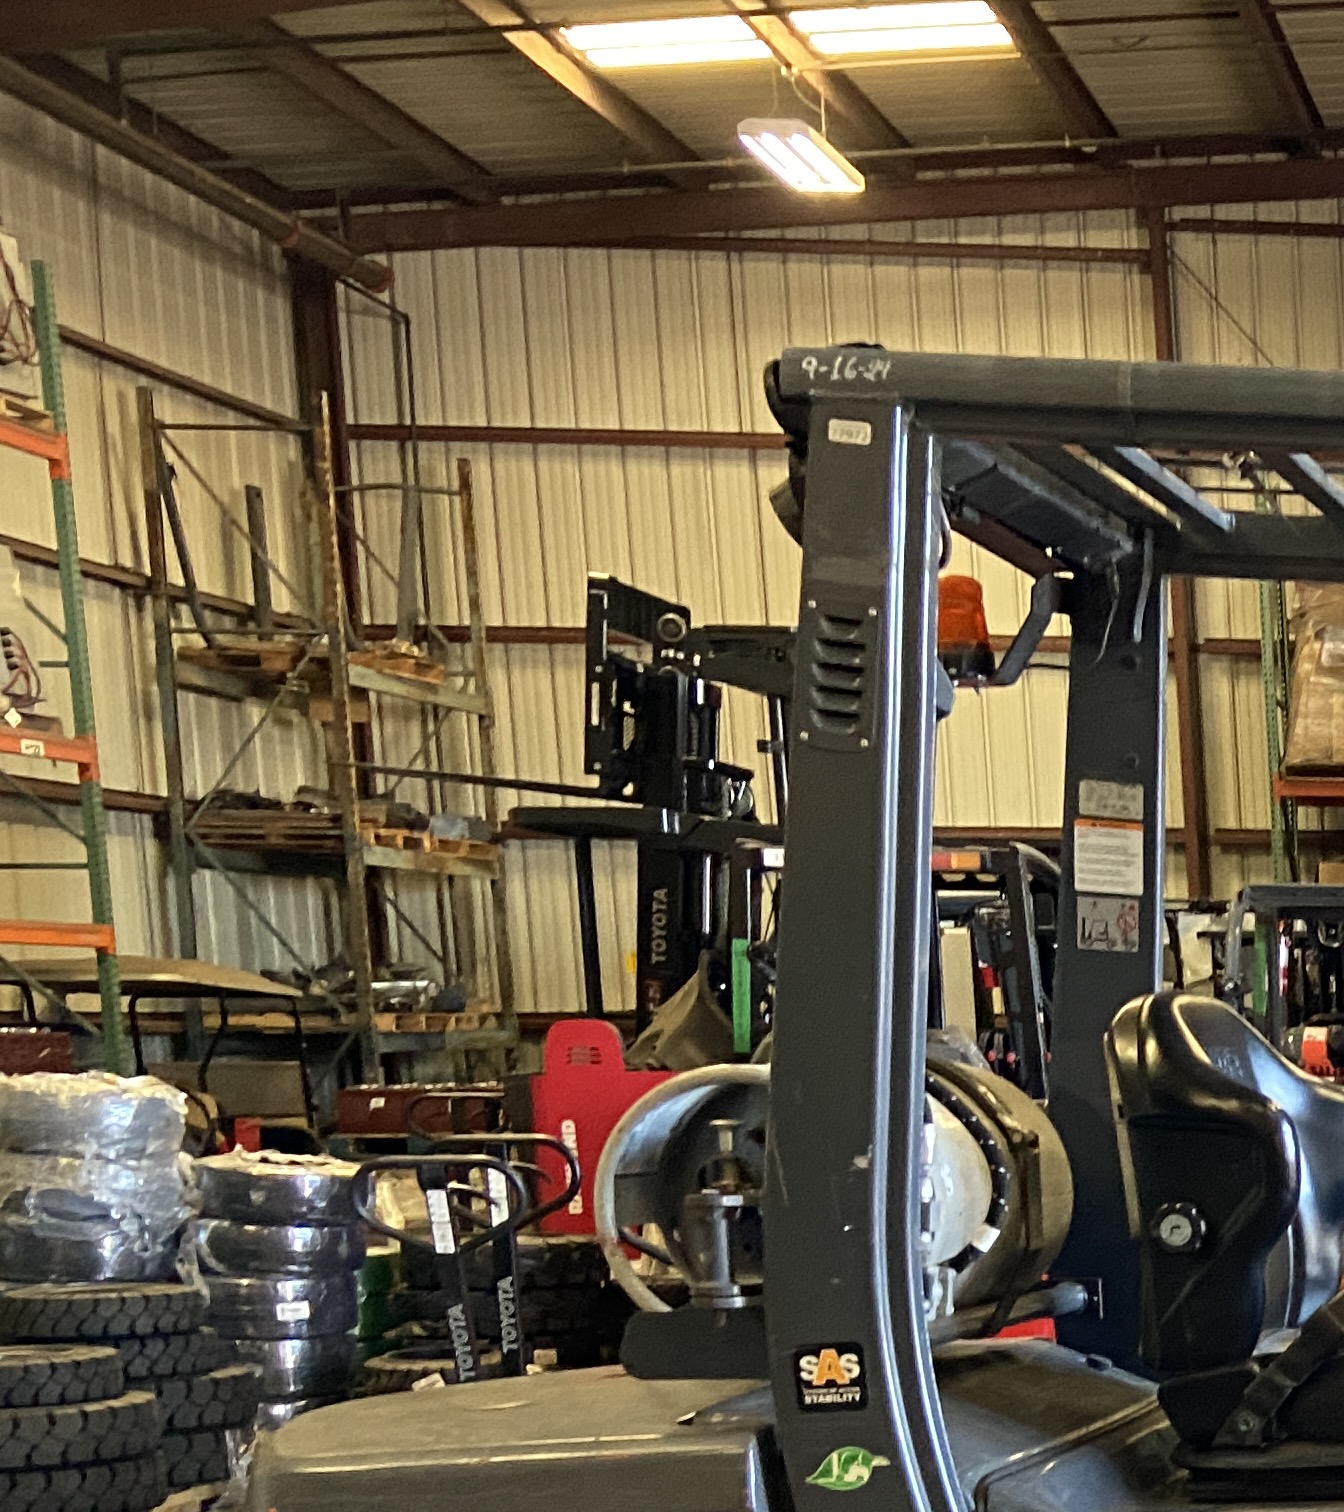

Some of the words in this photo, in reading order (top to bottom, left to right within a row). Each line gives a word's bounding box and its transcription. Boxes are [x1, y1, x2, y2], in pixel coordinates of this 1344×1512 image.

[651, 887, 669, 965] TOYOTA
[447, 1303, 477, 1381] TOYOTA
[497, 1276, 519, 1354] TOYOTA
[799, 1348, 861, 1387] SAS
[804, 1393, 861, 1406] STABILITY
